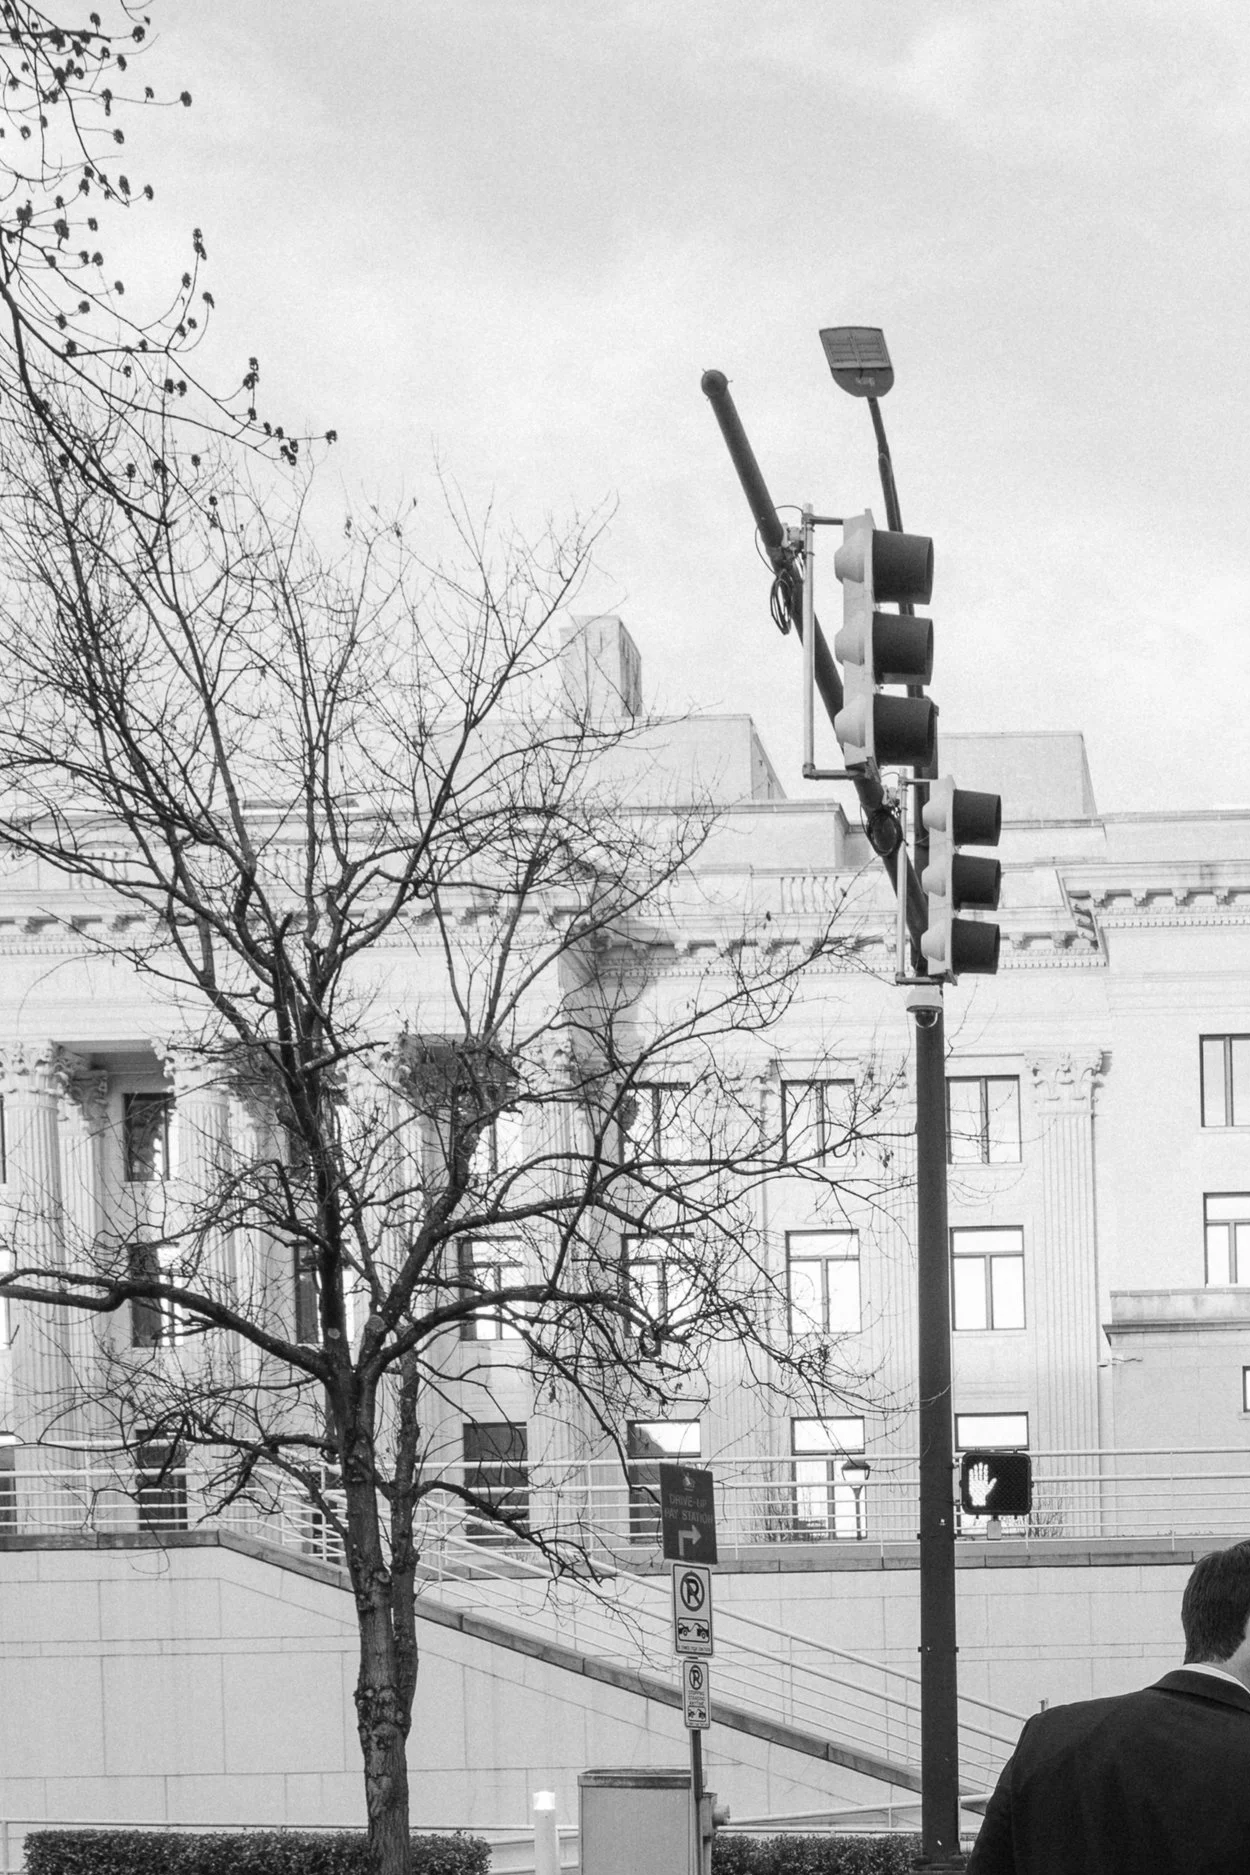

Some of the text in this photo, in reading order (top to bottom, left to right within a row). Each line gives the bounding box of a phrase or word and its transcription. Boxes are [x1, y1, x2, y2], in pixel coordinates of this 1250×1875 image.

[669, 1493, 707, 1509] DRIVE-UP
[664, 1507, 714, 1525] PAY STATION
